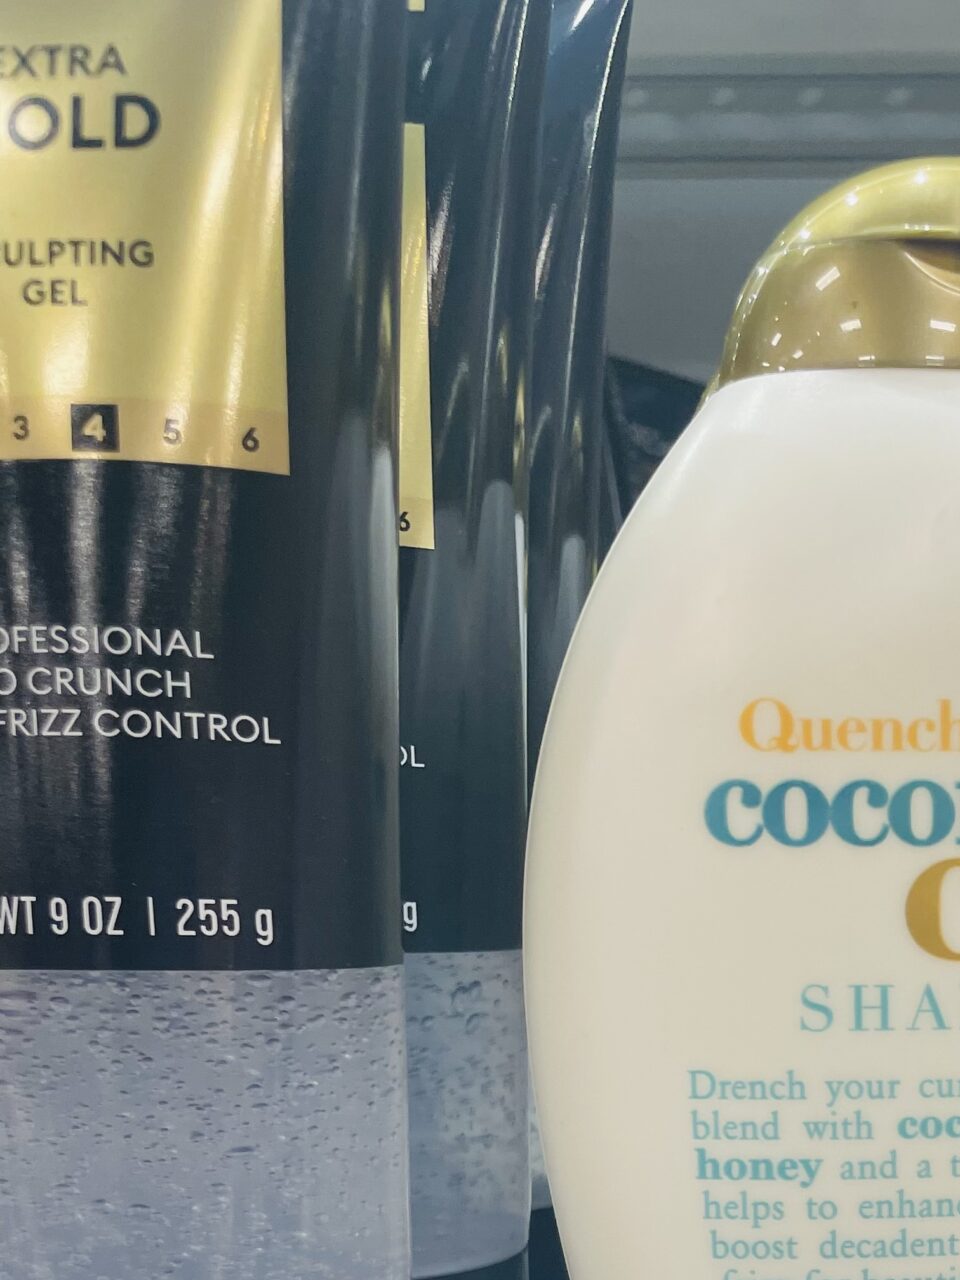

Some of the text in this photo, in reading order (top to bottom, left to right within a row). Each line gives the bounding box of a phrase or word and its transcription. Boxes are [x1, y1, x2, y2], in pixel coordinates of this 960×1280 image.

[23, 278, 88, 305] GEL
[13, 413, 259, 452] 3 4 5 6
[28, 666, 191, 699] CRUNCH
[94, 709, 281, 745] CONTROL
[50, 897, 68, 935] 9
[82, 896, 124, 935] OZ
[176, 899, 240, 937] 255
[255, 906, 275, 946] g
[403, 901, 418, 933] g
[688, 1069, 806, 1101] Drench
[825, 1077, 900, 1108] your
[691, 1110, 781, 1142] blend
[803, 1108, 873, 1141] with
[695, 1148, 824, 1188] honey
[840, 1149, 898, 1181] and
[917, 1157, 932, 1179] a
[702, 1190, 785, 1228] helps
[806, 1195, 838, 1222] to
[710, 1230, 798, 1261] boost
[819, 1227, 960, 1259] decadent
